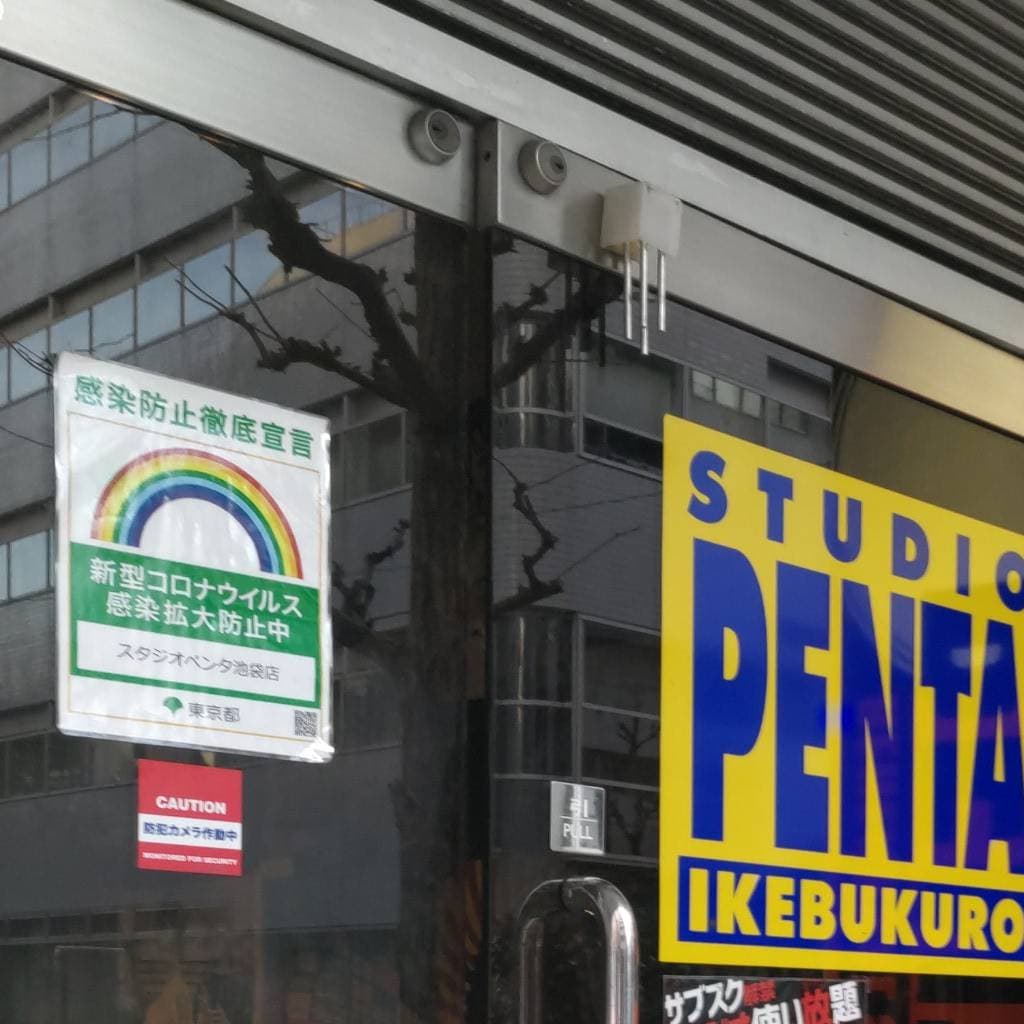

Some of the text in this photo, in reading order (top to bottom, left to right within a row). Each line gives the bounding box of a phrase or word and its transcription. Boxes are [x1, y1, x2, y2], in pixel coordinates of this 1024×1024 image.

[74, 374, 315, 460] 感染防止徹底宣言
[89, 557, 303, 618] 新型コロナウイルス
[106, 591, 290, 642] 感染拡大防止中
[188, 702, 241, 723] 東京都
[155, 795, 227, 815] CAUTION
[143, 821, 238, 841] 防犯カメラ作動中
[563, 822, 594, 840] PULL
